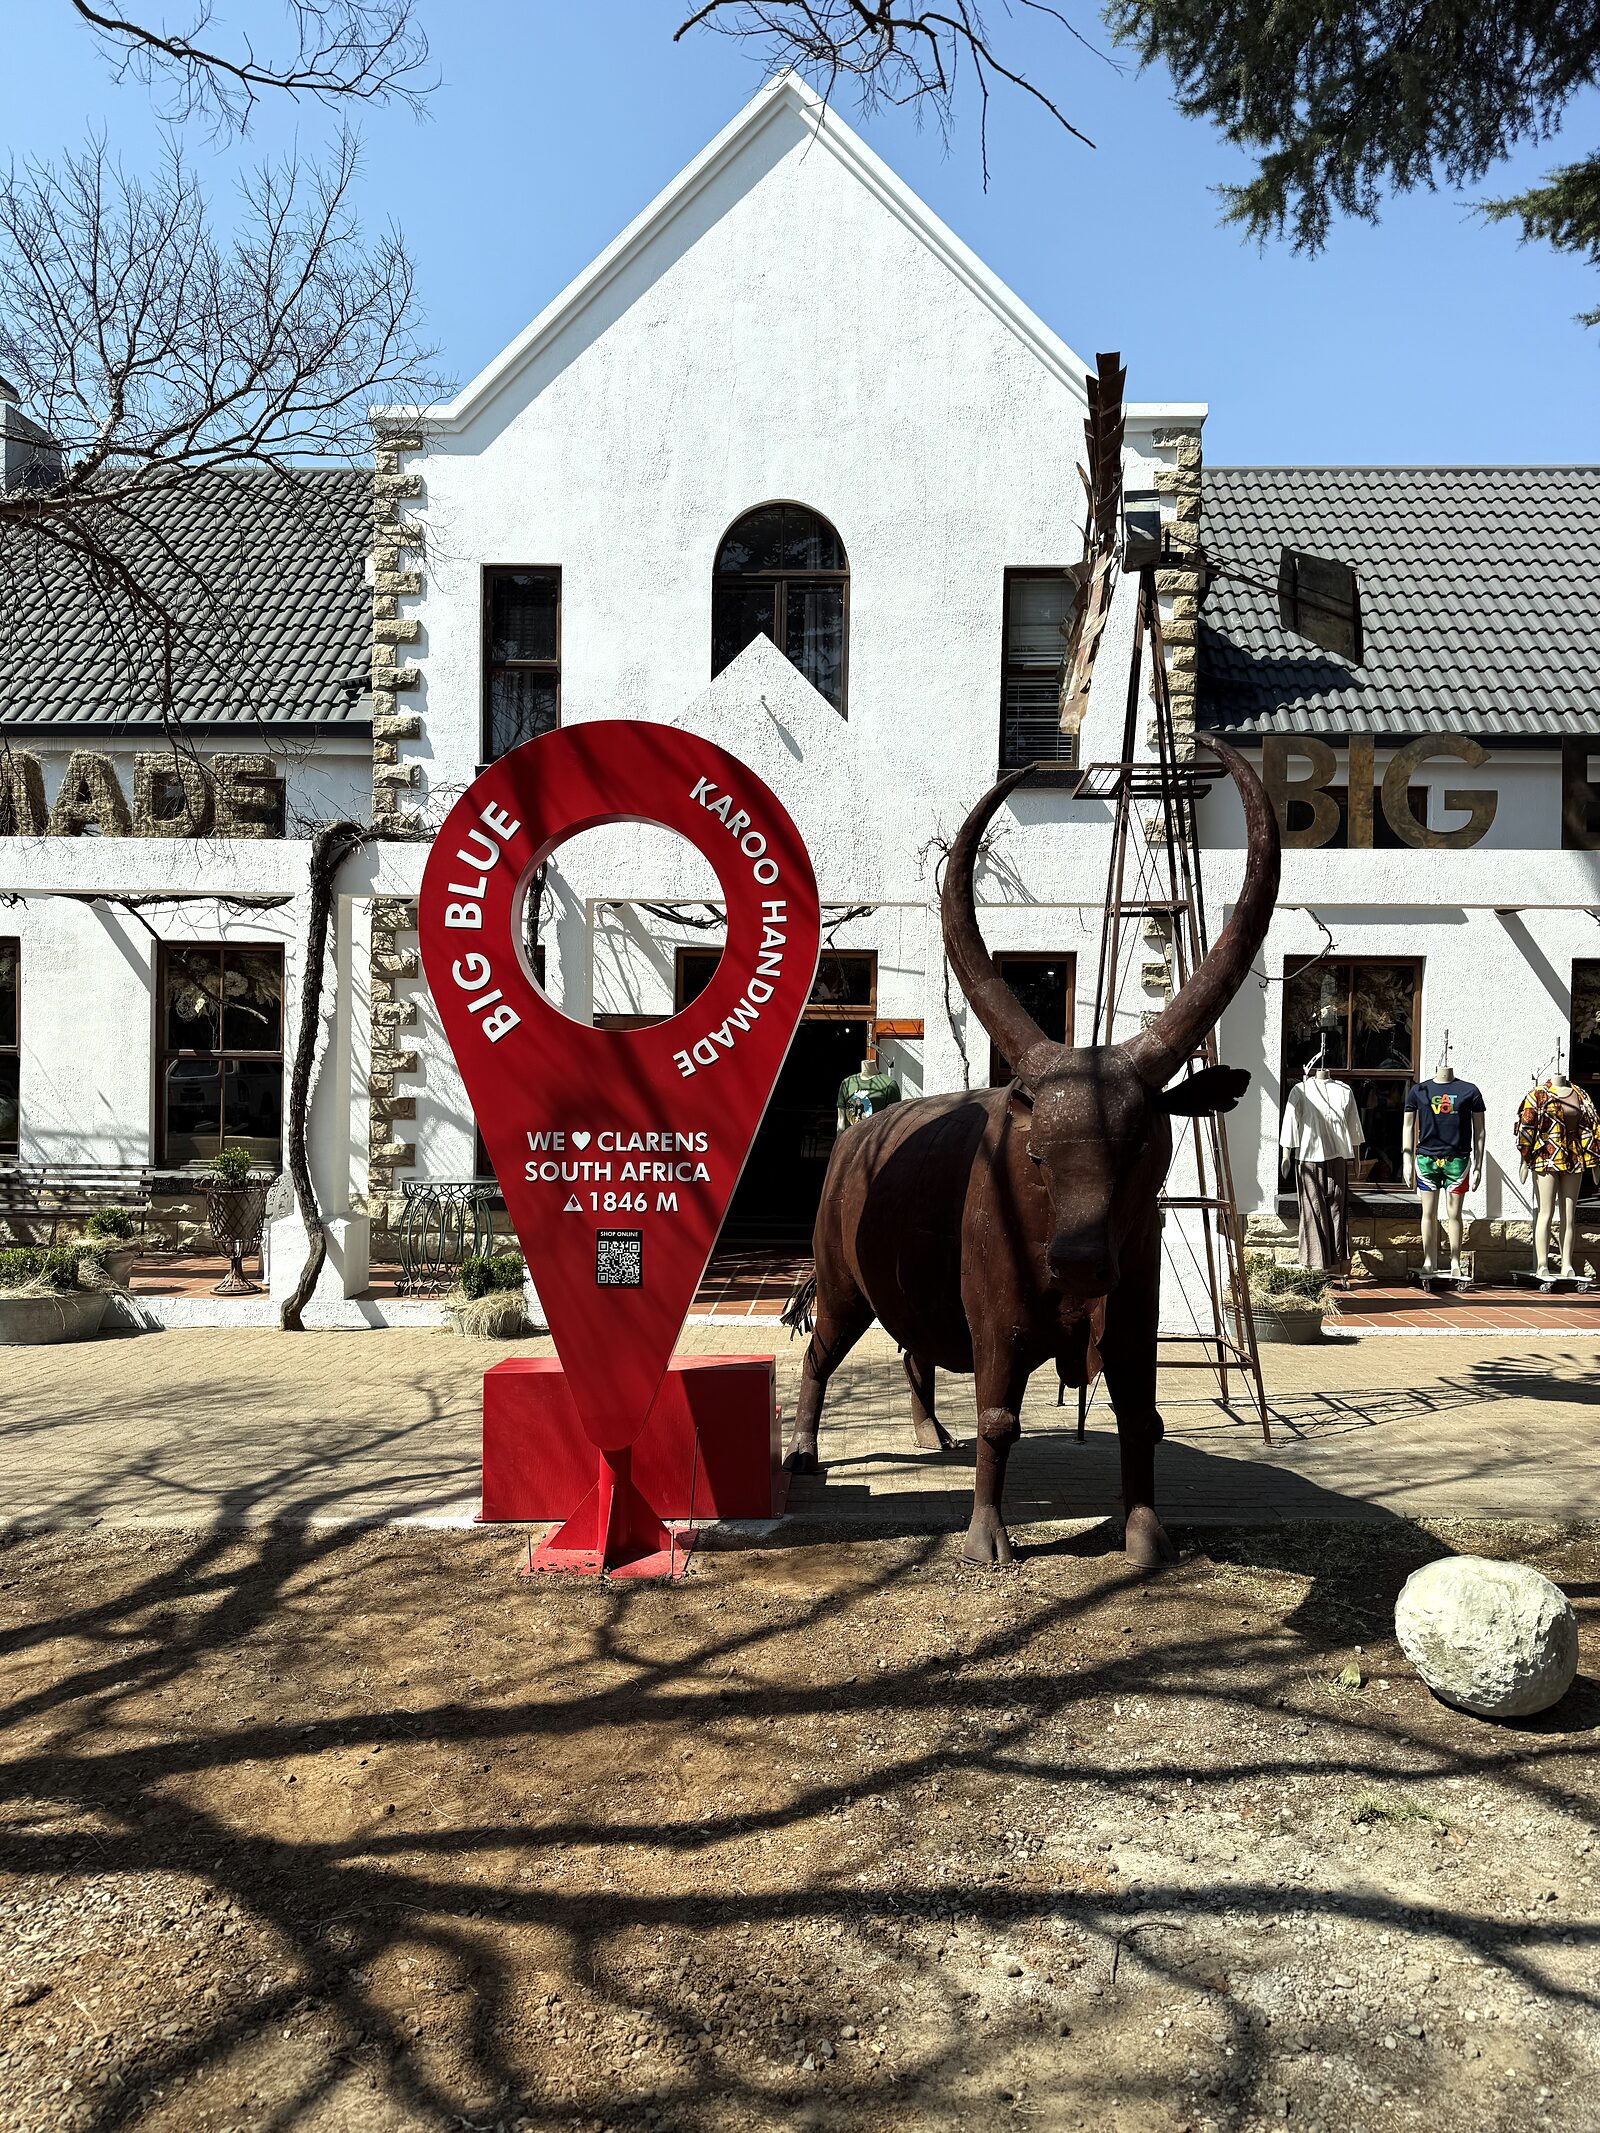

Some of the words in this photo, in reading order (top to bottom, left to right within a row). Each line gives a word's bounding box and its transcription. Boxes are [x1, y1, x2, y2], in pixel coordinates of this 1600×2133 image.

[689, 776, 779, 885] KAROO
[1262, 735, 1498, 849] BIG
[445, 800, 521, 928] BLUE
[452, 953, 521, 1043] BIG
[672, 900, 787, 1078] HANDMADE
[525, 1161, 612, 1182] SOUTH
[619, 1162, 711, 1182] AFRICA
[527, 1131, 565, 1151] WE
[597, 1131, 709, 1152] CLARENS
[589, 1191, 648, 1212] 1846
[656, 1191, 679, 1212] M
